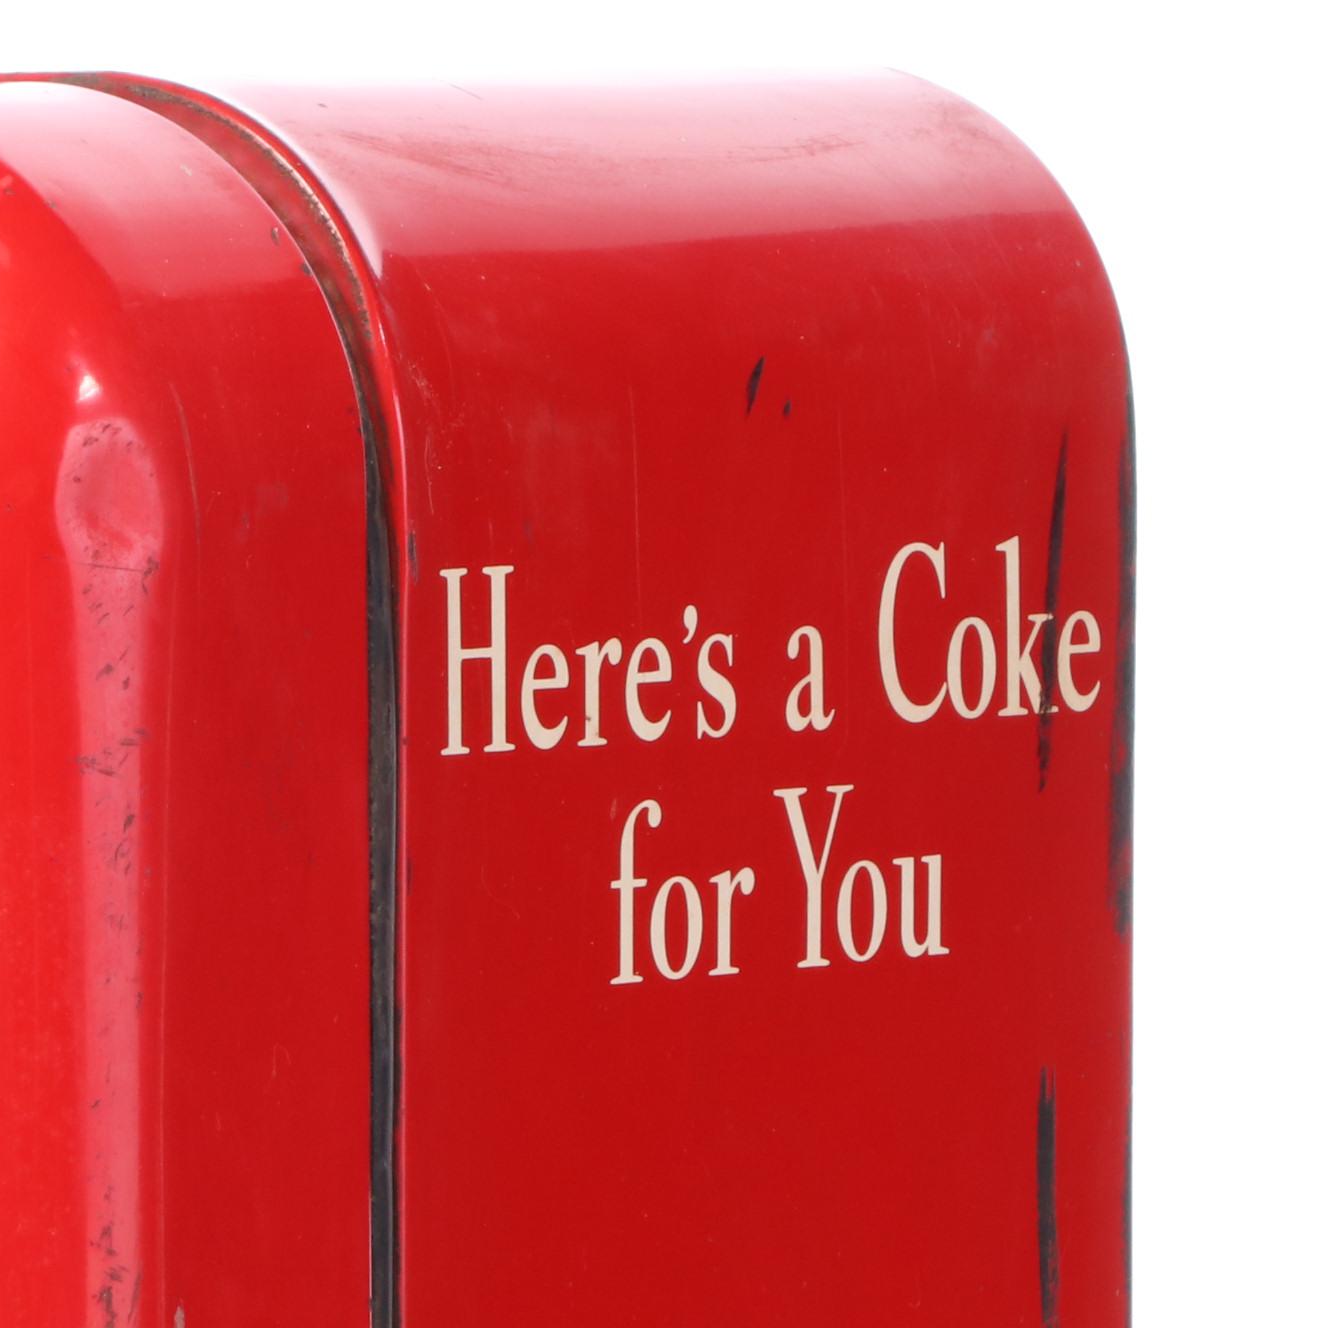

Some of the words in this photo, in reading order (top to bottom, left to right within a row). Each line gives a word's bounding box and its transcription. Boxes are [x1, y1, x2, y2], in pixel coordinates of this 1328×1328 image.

[440, 566, 737, 755] Here's
[786, 626, 834, 732] a
[879, 536, 1101, 723] Coke
[610, 800, 754, 985] for
[774, 785, 950, 968] You
